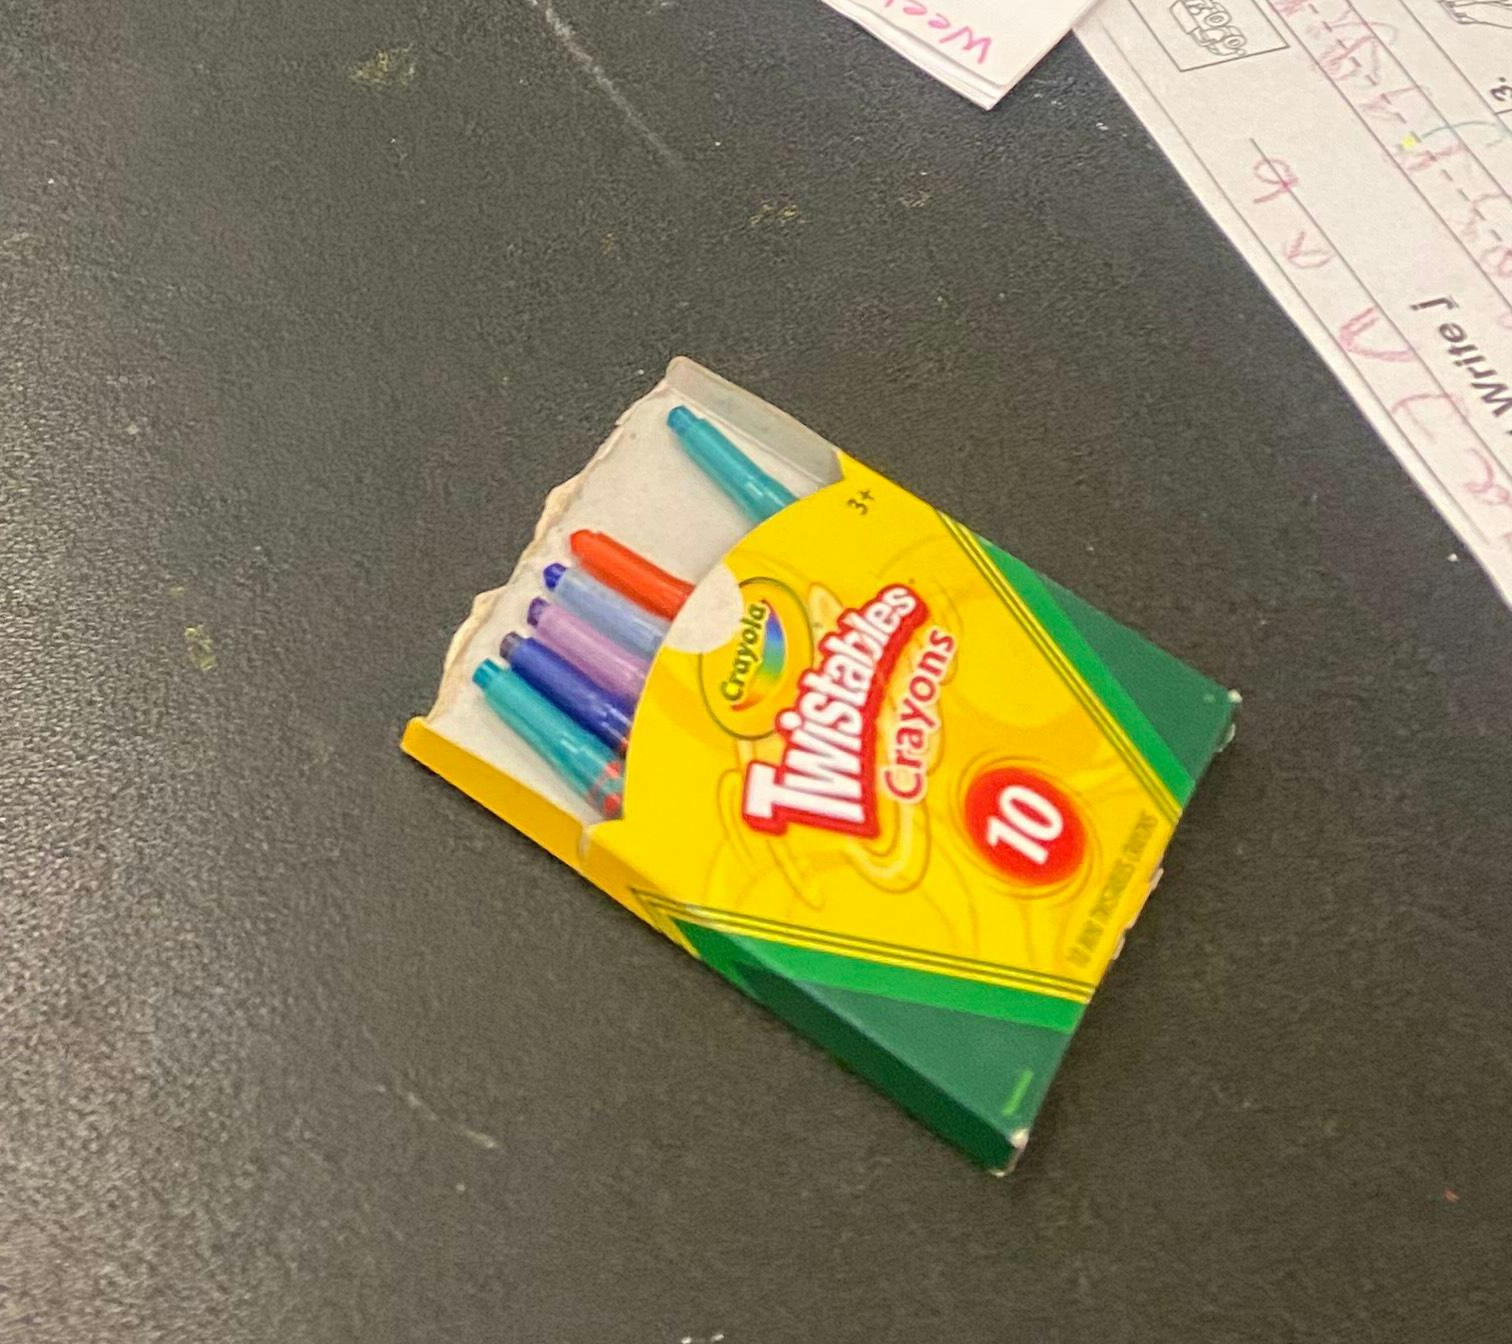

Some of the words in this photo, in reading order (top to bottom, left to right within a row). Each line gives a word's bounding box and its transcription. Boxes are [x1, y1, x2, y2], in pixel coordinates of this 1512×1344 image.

[1439, 321, 1512, 419] Write
[846, 489, 875, 515] 3+
[720, 601, 767, 702] Crayola
[744, 586, 918, 825] Twistables
[886, 628, 955, 800] Crayons
[987, 784, 1064, 866] 10
